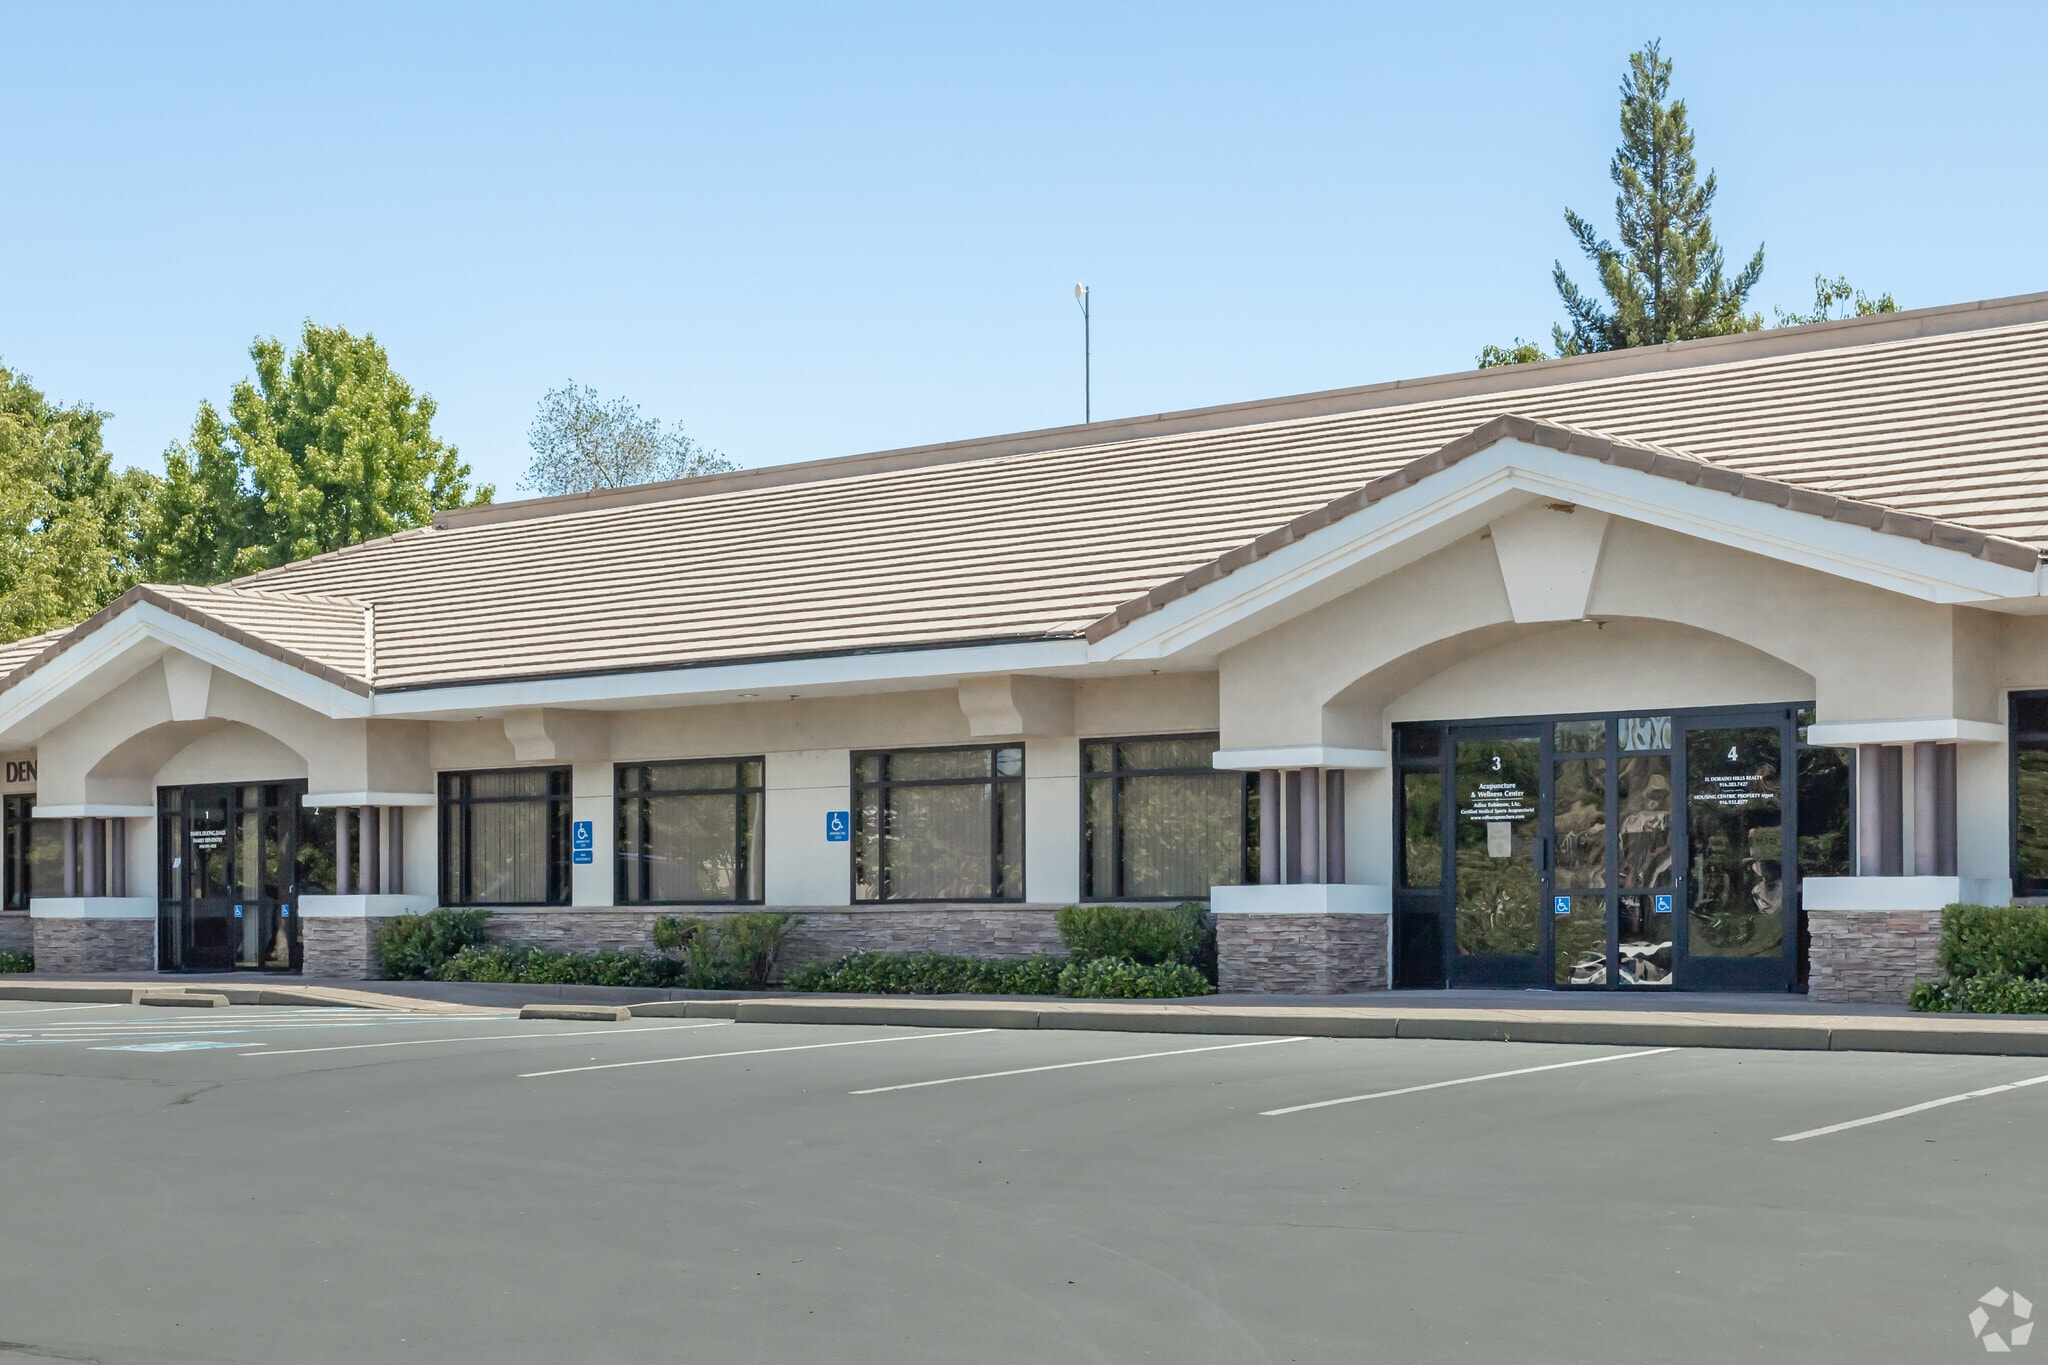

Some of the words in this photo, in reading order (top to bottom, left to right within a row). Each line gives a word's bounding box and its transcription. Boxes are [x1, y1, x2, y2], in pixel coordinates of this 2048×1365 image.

[1727, 746, 1738, 761] 4
[1492, 756, 1501, 770] 3
[6, 760, 37, 783] DEN
[1479, 783, 1516, 791] Acupuncture
[205, 811, 209, 819] 1
